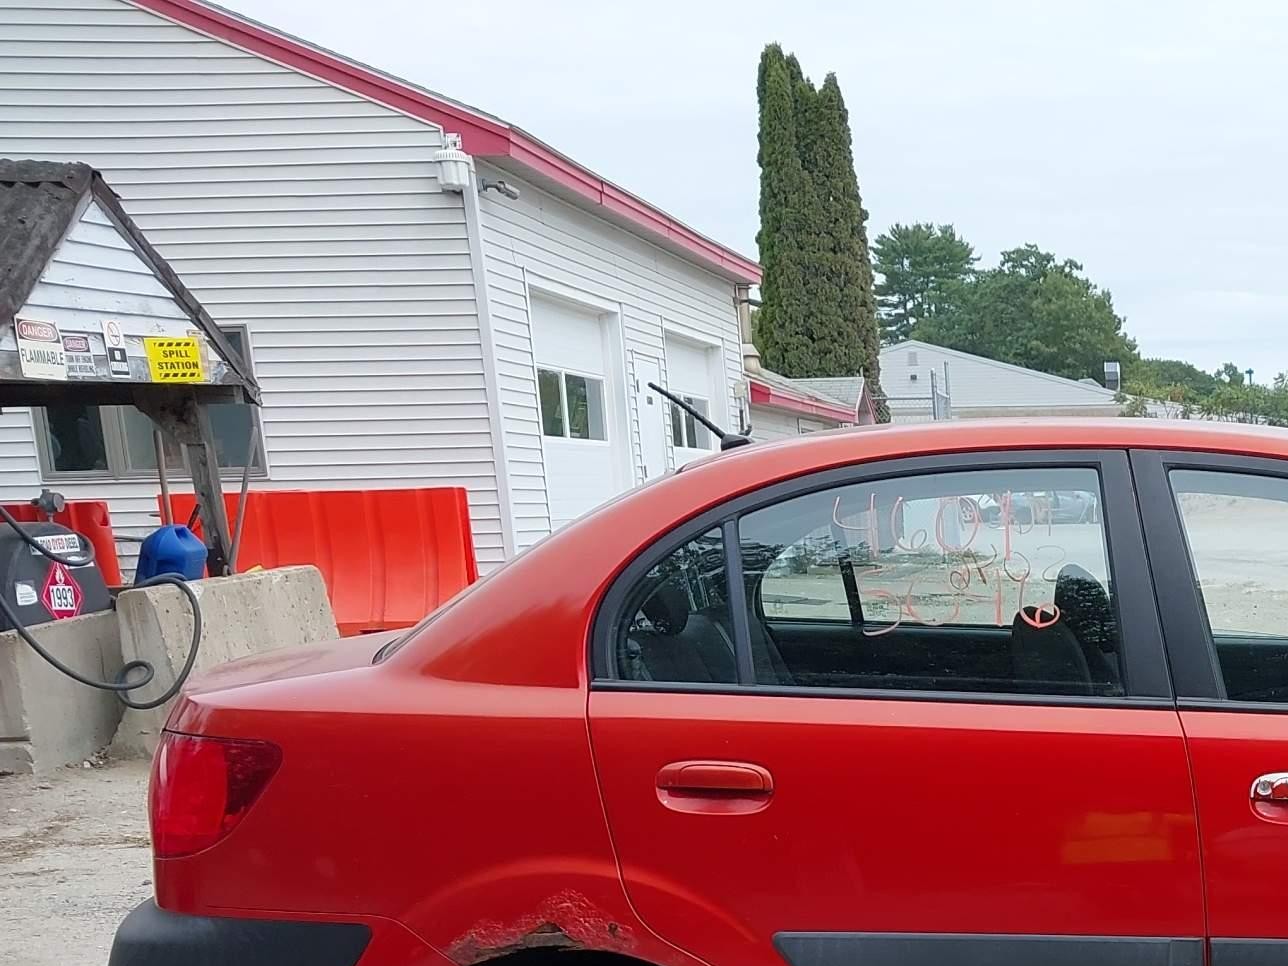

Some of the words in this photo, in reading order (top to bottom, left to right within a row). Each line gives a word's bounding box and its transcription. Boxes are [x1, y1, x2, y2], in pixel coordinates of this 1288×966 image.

[22, 324, 55, 338] DANGER
[20, 348, 65, 366] FLAMMABLE
[162, 349, 191, 359] SPILL
[158, 360, 199, 370] STATION
[51, 587, 74, 608] 1993
